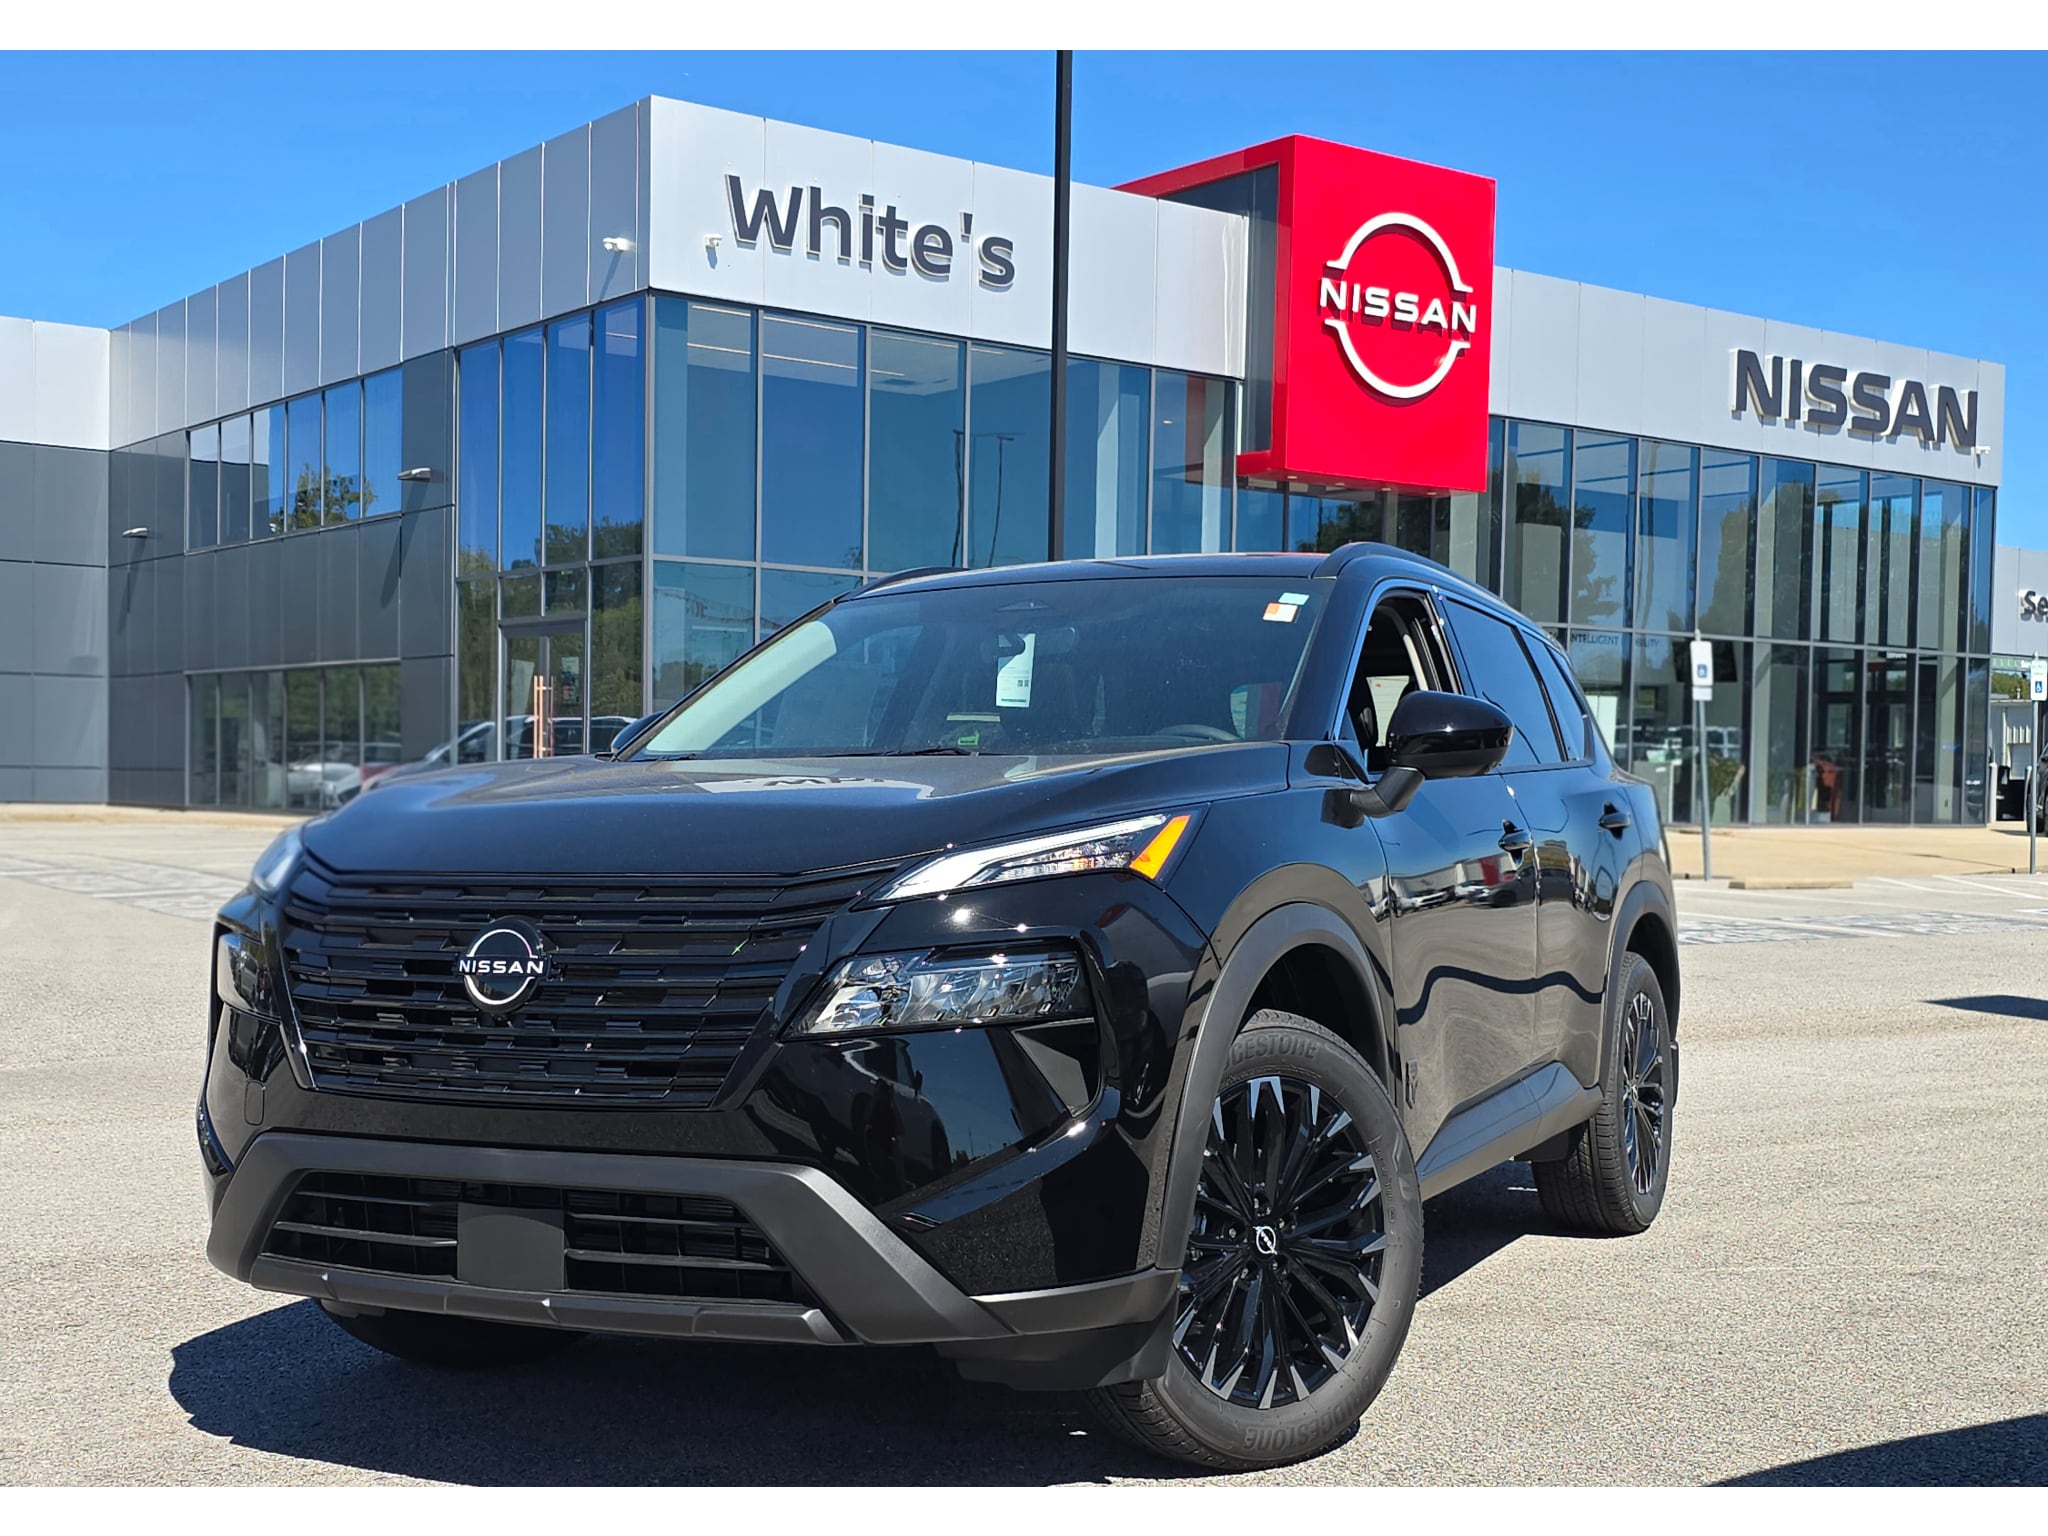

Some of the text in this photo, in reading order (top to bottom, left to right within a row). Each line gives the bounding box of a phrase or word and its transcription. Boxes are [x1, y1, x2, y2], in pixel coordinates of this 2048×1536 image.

[725, 174, 1016, 287] White's
[1319, 277, 1477, 333] NISSAN
[1733, 348, 1978, 448] NISSAN
[1570, 633, 1620, 646] NTELLIGENT
[459, 959, 544, 974] NISSAN
[1228, 1034, 1318, 1066] GESTONE
